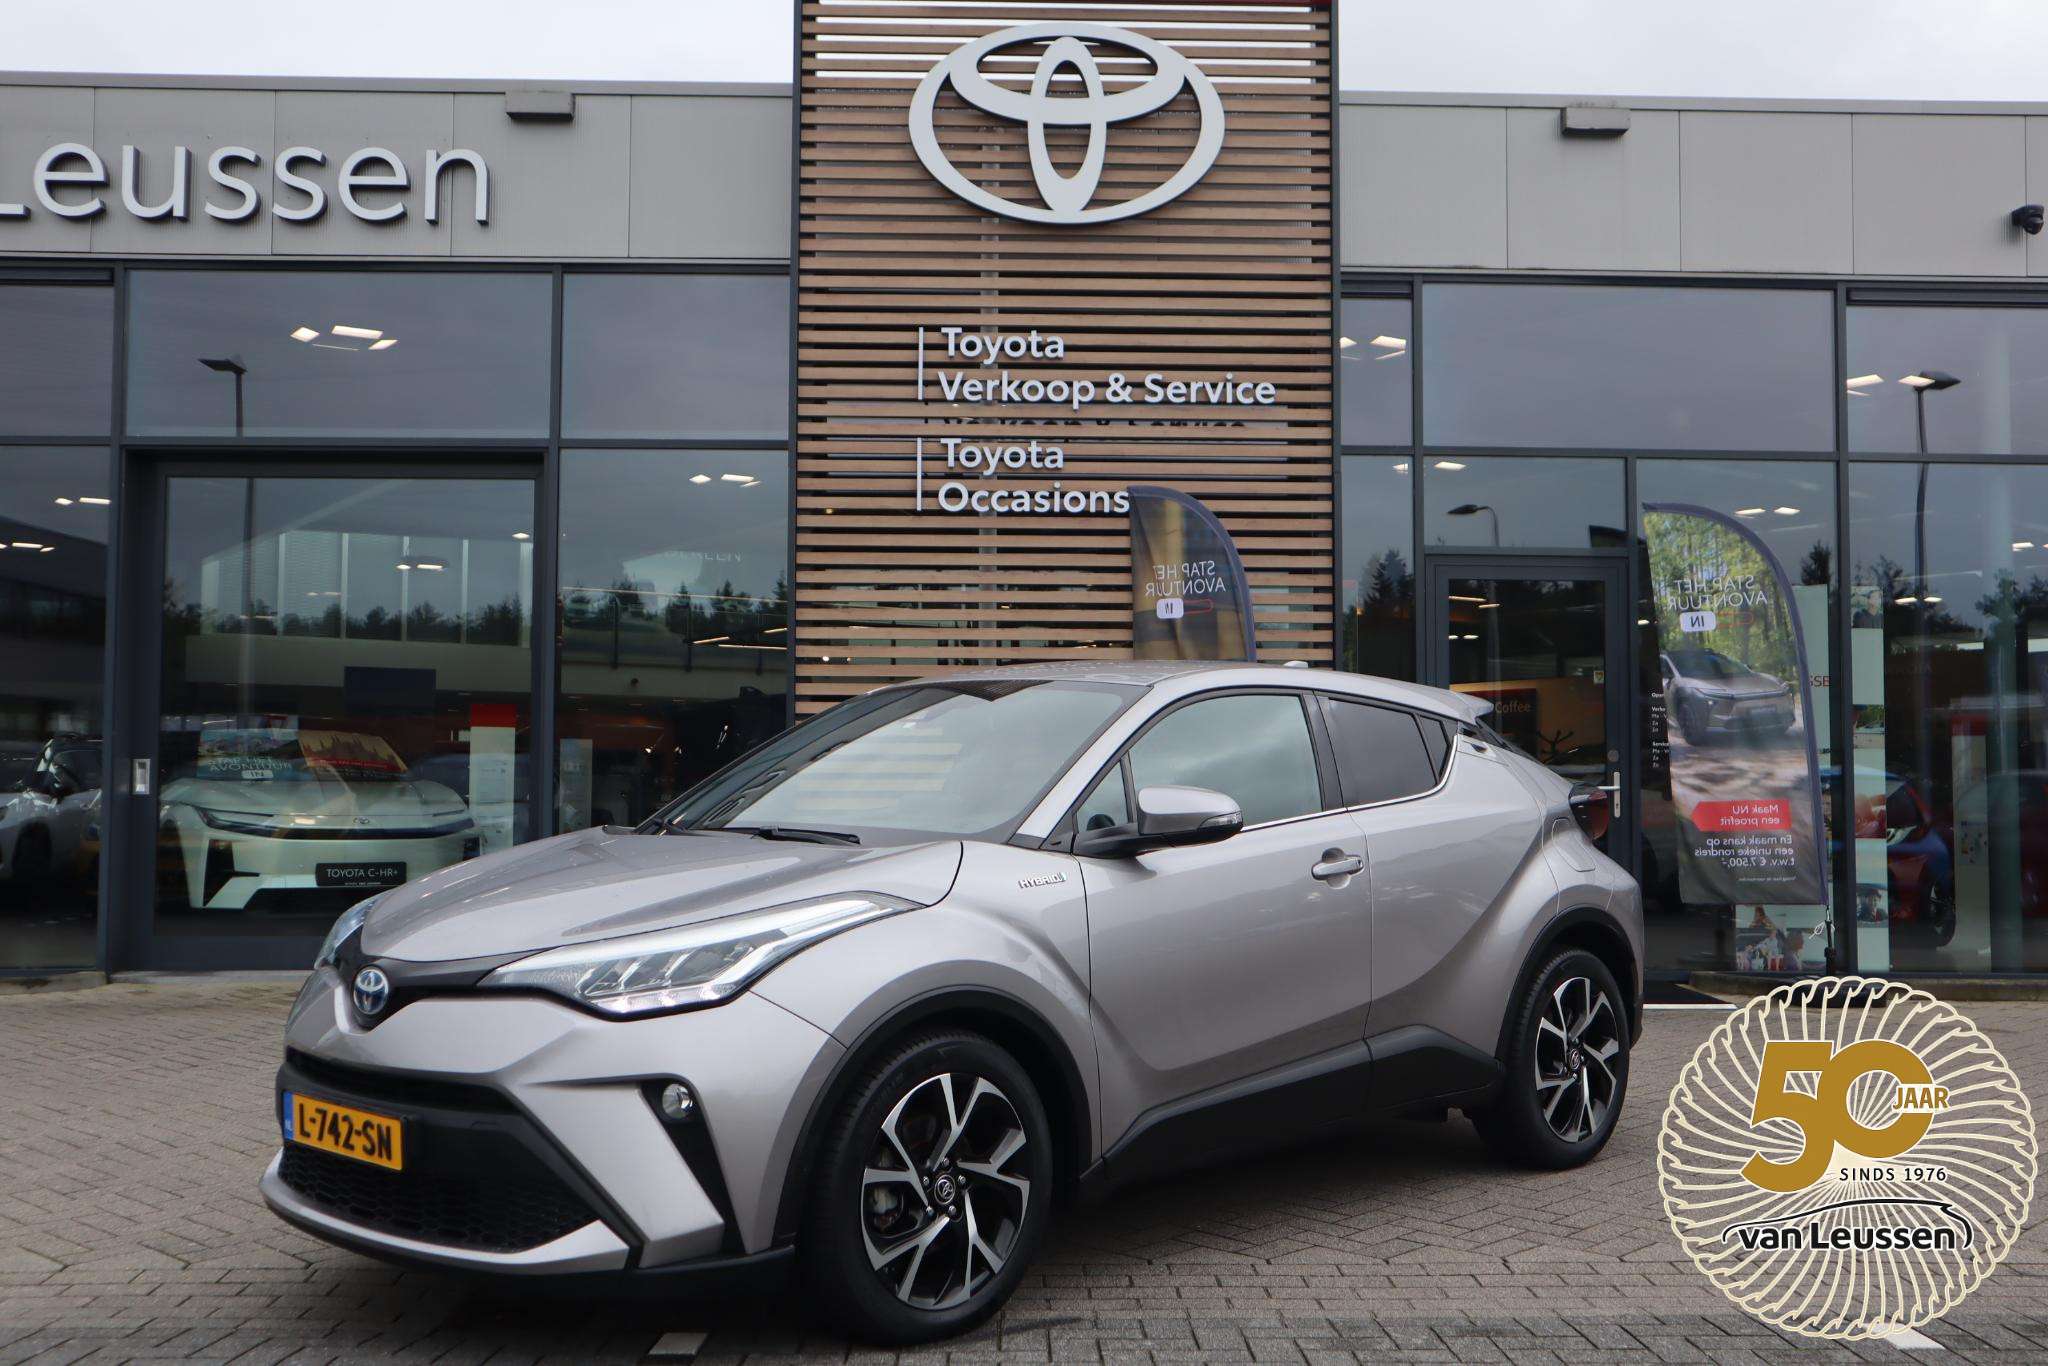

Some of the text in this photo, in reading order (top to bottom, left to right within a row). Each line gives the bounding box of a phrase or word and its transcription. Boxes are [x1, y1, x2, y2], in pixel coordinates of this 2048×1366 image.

[940, 326, 1065, 364] Toyota
[937, 370, 1277, 411] Verkoop & Service
[940, 437, 1064, 476] Toyota
[937, 481, 1131, 513] Occasions
[1494, 700, 1531, 714] Coffee
[326, 868, 399, 878] TOYOTA C-HR+
[1017, 871, 1067, 889] HYBRID
[298, 1102, 393, 1162] L-742-SN
